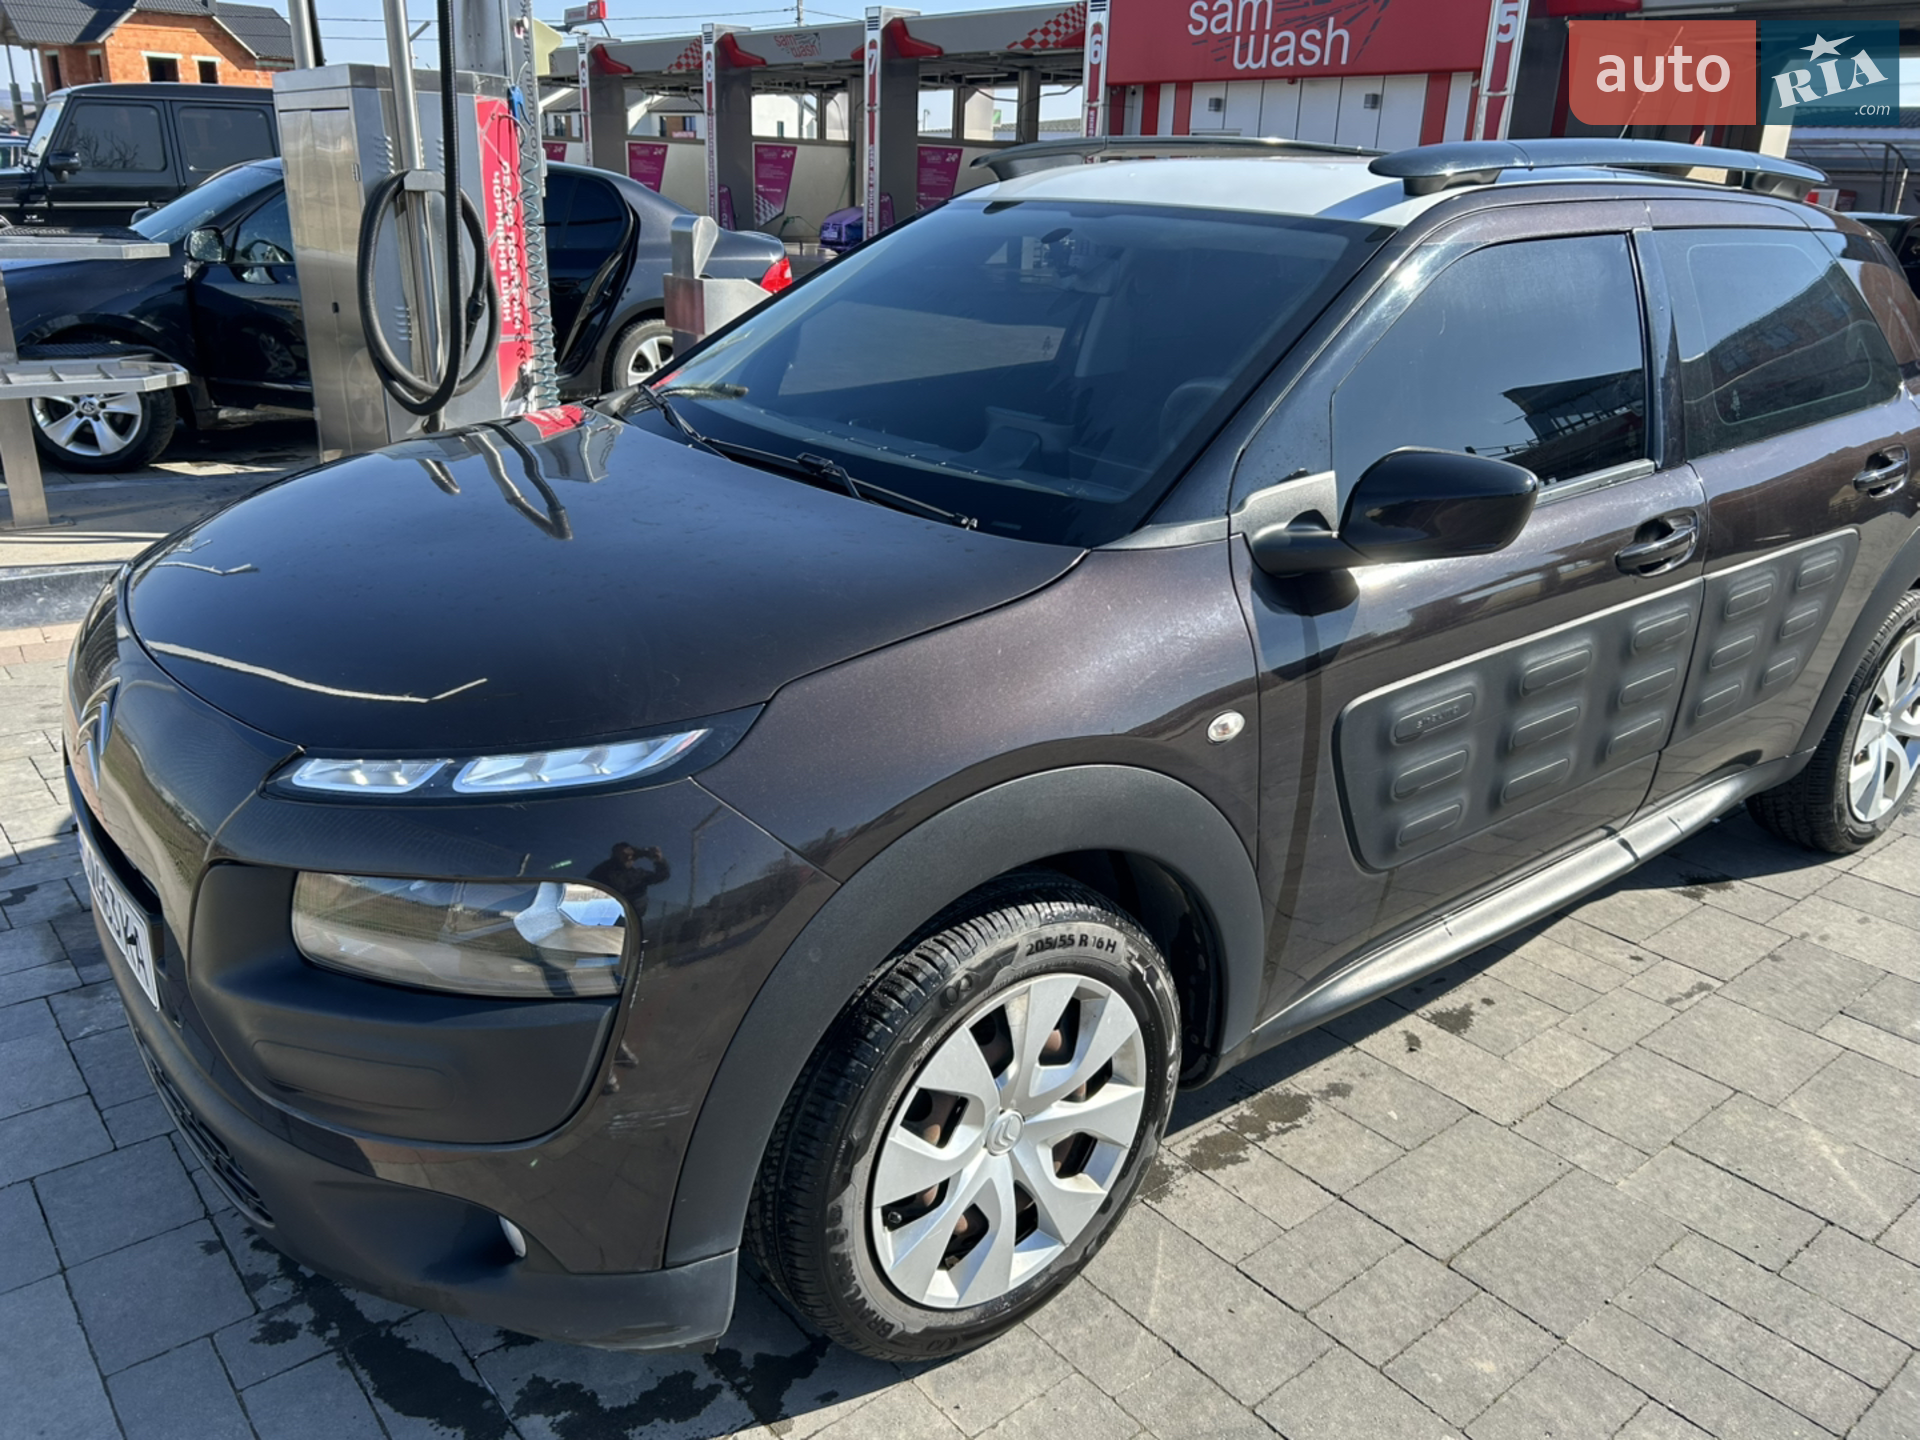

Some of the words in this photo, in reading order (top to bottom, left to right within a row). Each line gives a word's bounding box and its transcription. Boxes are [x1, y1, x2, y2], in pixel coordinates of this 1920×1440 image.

[1188, 0, 1273, 36] sam
[1497, 3, 1519, 43] 5
[773, 34, 798, 47] sam
[789, 43, 820, 58] wash
[1089, 33, 1103, 65] 6
[1232, 16, 1350, 70] wash
[705, 59, 713, 82] 8
[868, 49, 877, 75] 7
[493, 172, 508, 271] ЧОРНІННЯ
[501, 276, 512, 322] ШИН
[1025, 934, 1076, 957] 205/55
[1078, 933, 1089, 947] R
